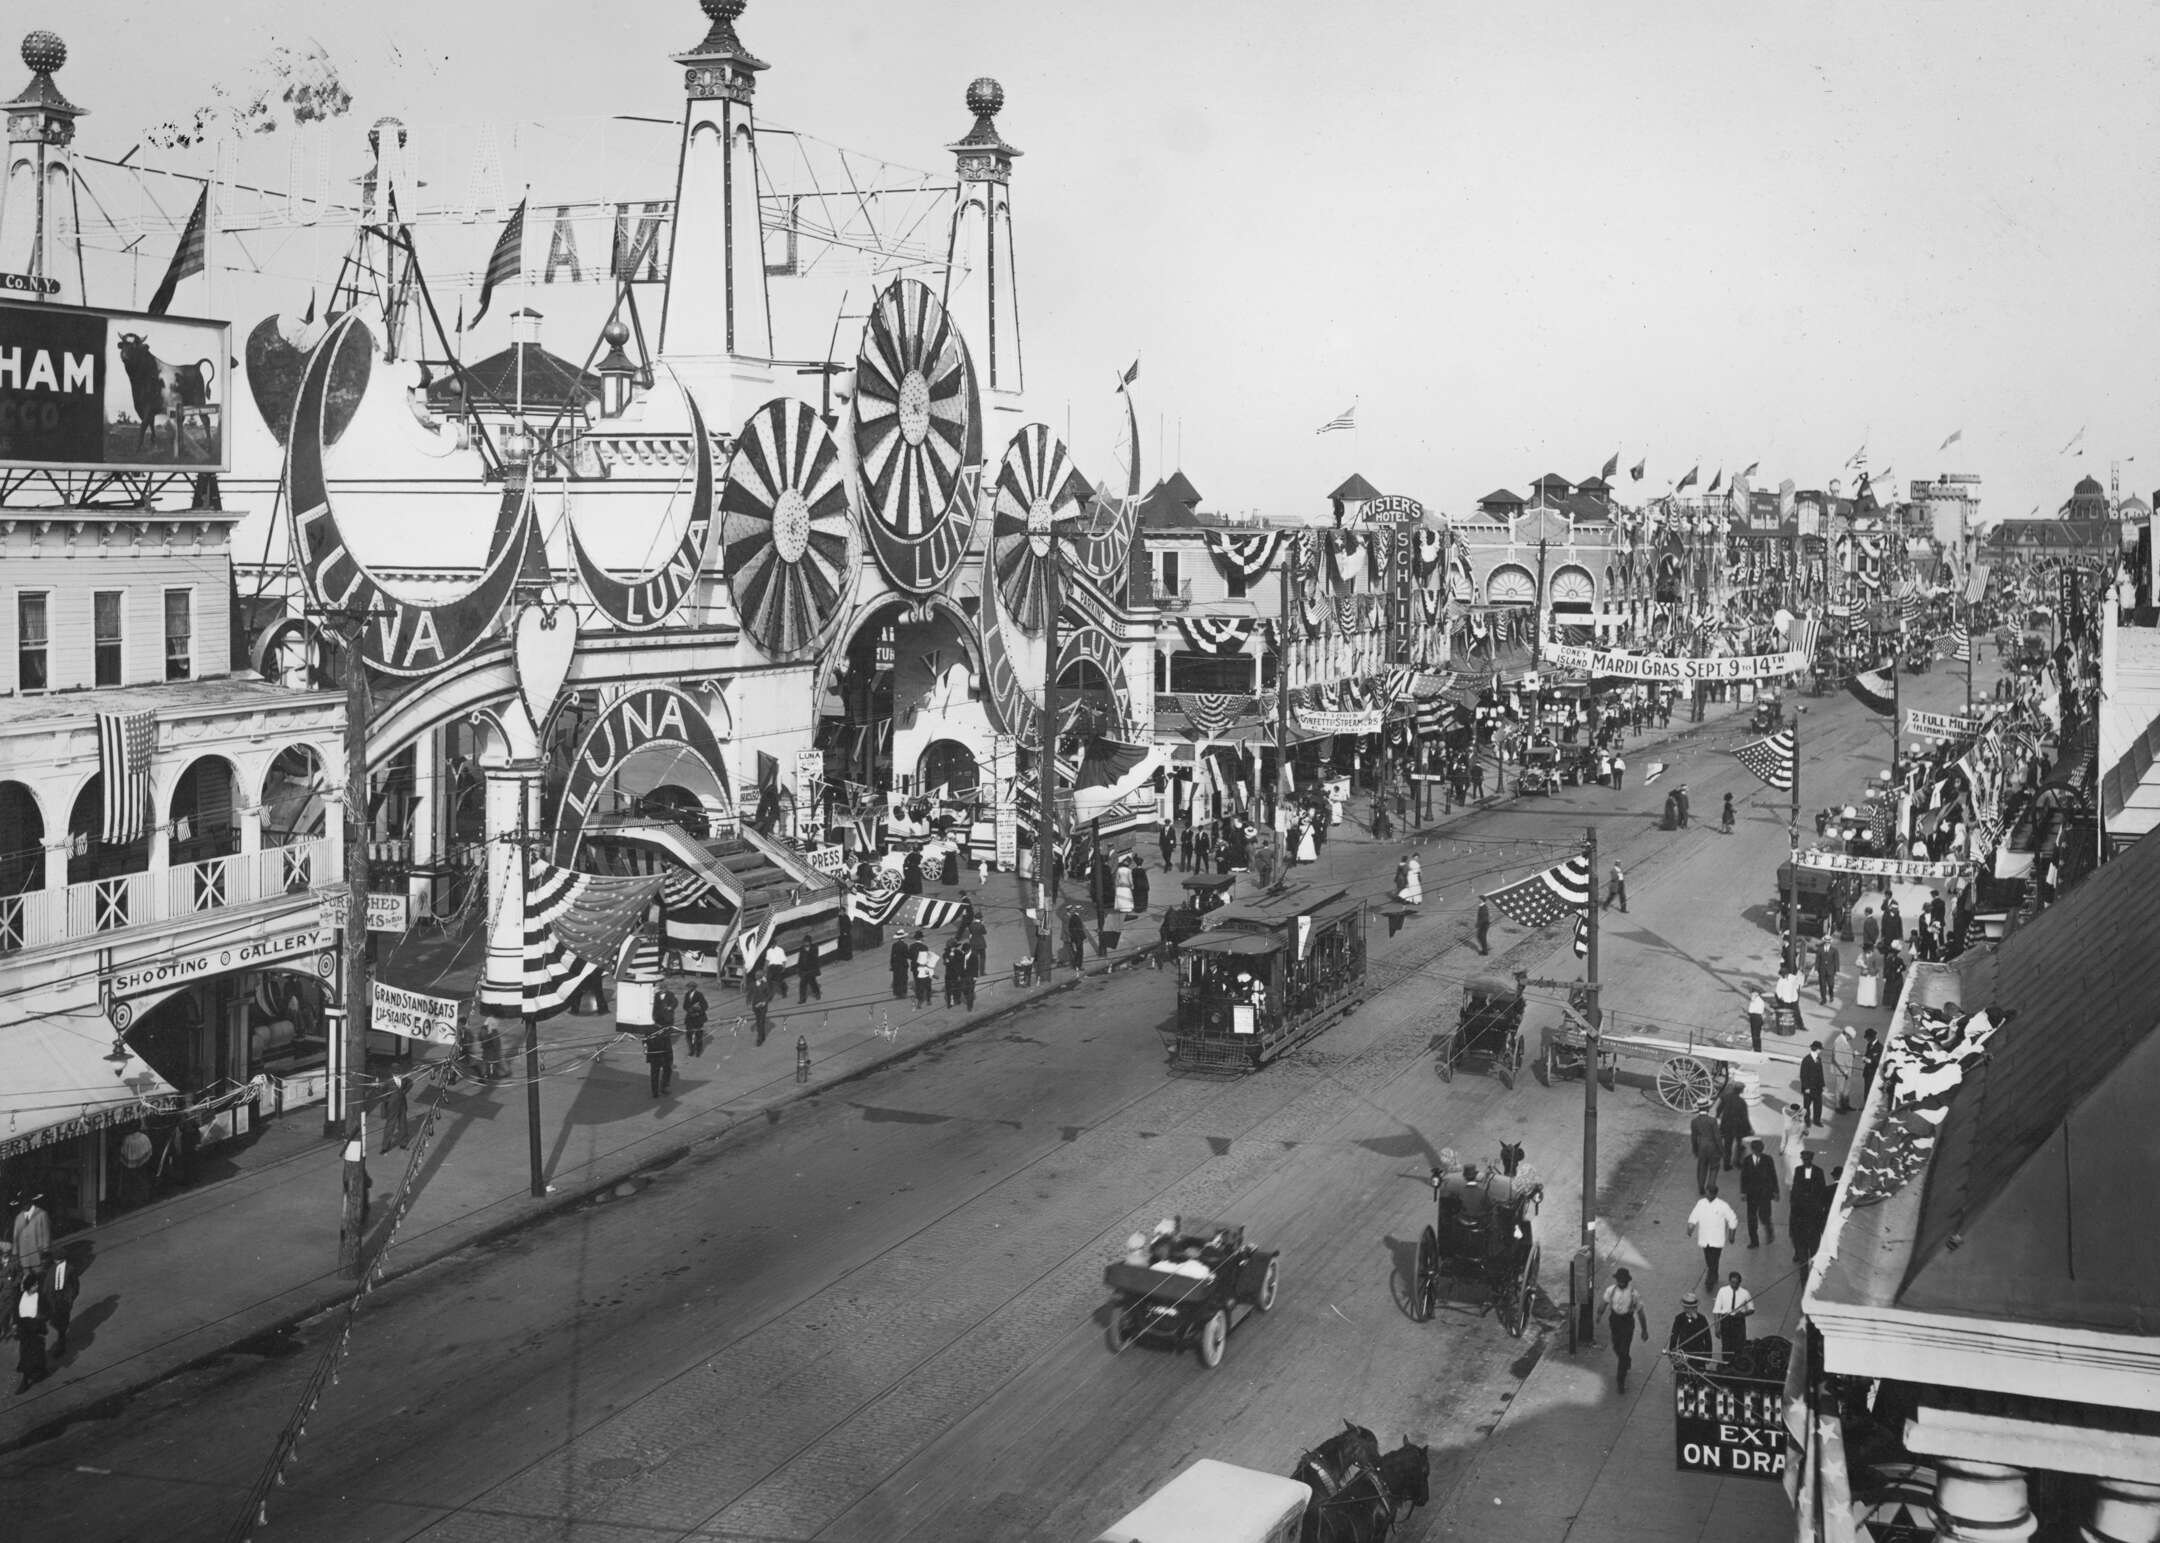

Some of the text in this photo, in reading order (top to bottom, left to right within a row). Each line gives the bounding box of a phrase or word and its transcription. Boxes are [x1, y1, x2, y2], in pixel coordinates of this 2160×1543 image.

[1361, 497, 1421, 520] KISTER'S
[1376, 511, 1409, 522] HOTEL
[916, 465, 982, 588] LUNA
[1087, 495, 1139, 574] LUNA
[297, 502, 444, 668] LUNA
[627, 520, 709, 624] LUNA
[1397, 532, 1409, 654] SCHLITZ
[1080, 591, 1126, 636] PARKING FREE
[1557, 655, 1588, 667] ISLAND
[1560, 647, 1586, 657] CONEY
[1591, 653, 1638, 675] MARDI
[1642, 659, 1680, 677] GRAS
[1685, 660, 1724, 678] SEPT.
[1730, 660, 1740, 677] 9
[1335, 716, 1379, 728] STREAMRS
[1922, 714, 1947, 728] FULL
[567, 692, 689, 817] LUNA
[116, 931, 320, 990] SHOOTING GALLERY
[1684, 1443, 1720, 1467] ON
